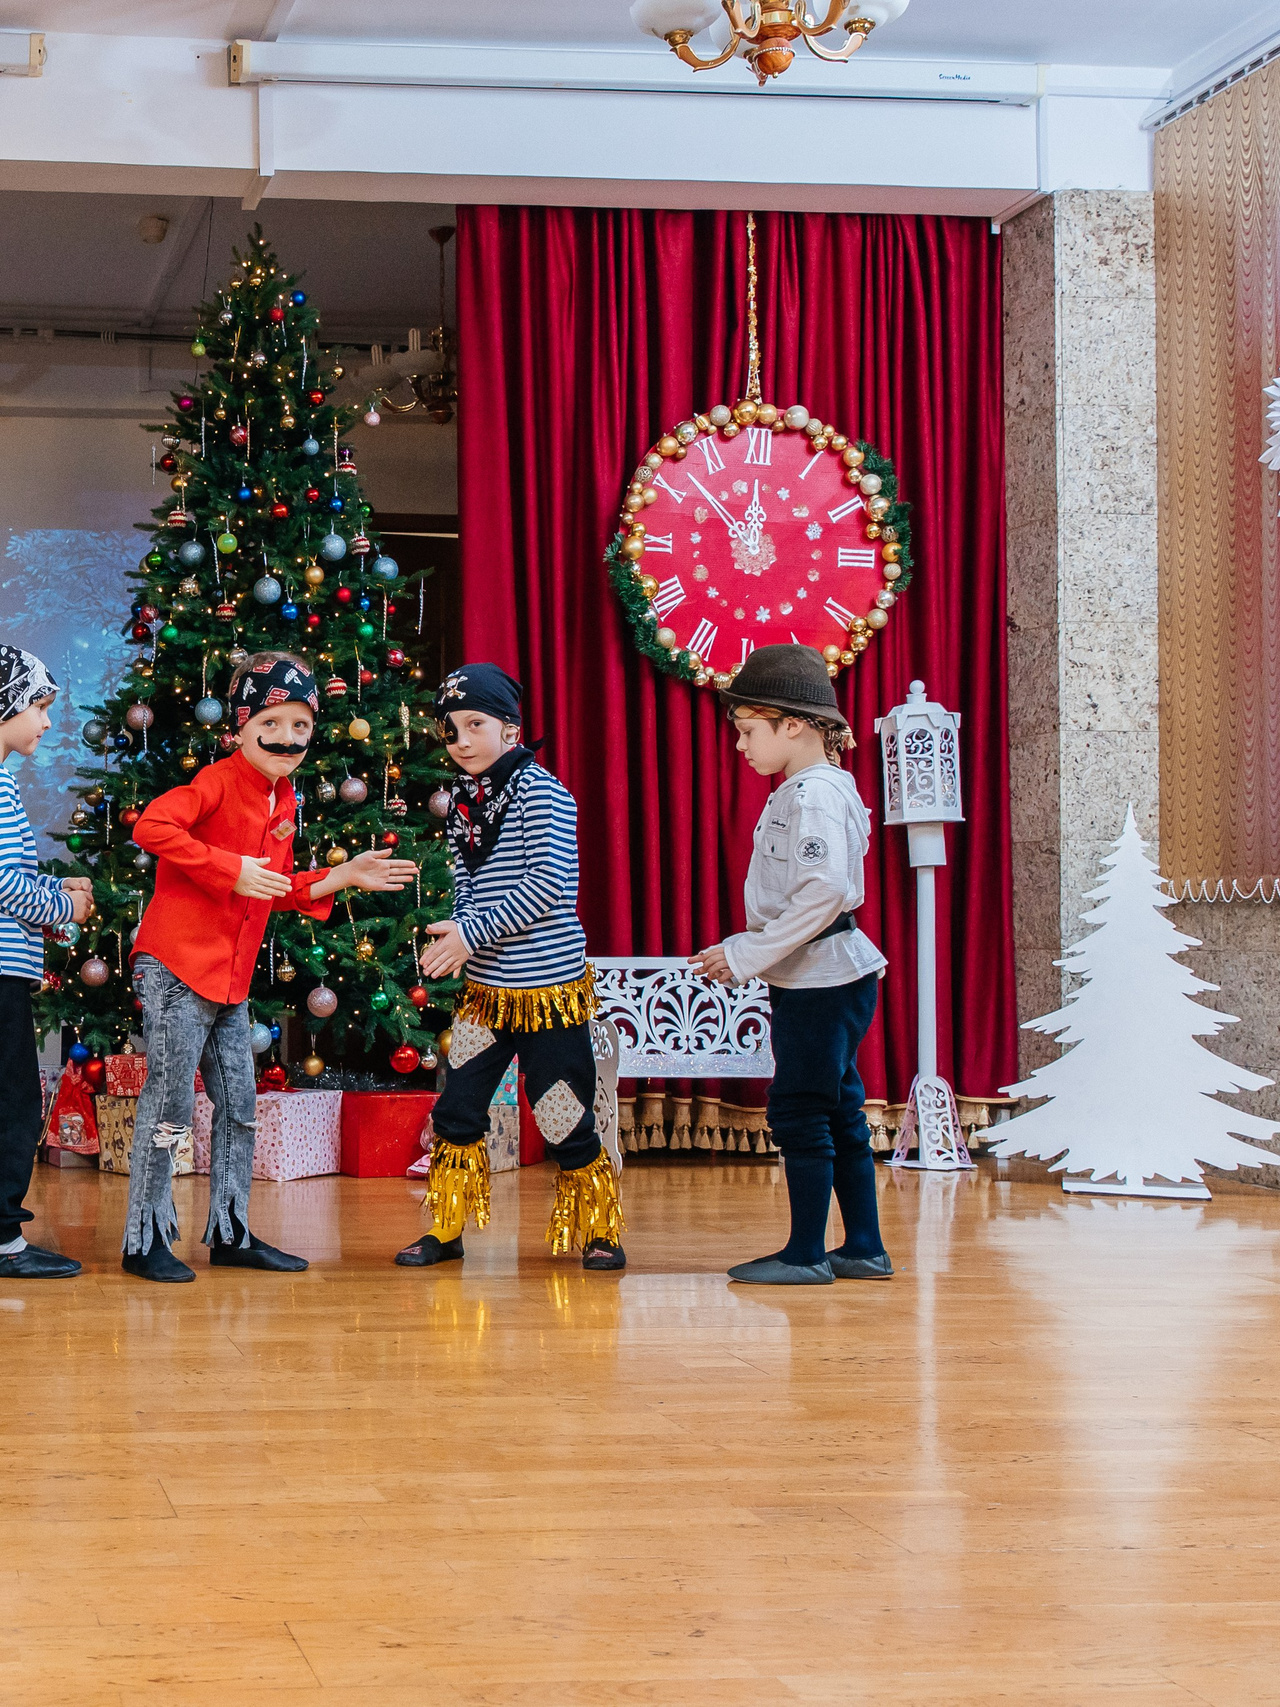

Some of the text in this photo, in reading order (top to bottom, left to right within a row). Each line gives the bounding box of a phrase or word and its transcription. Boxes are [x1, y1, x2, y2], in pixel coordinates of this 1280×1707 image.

[694, 435, 726, 475] XI
[744, 427, 773, 466] XII
[652, 472, 687, 504] X
[827, 494, 864, 523] II
[643, 532, 673, 555] IX
[837, 547, 875, 569] III
[686, 617, 718, 662] VII
